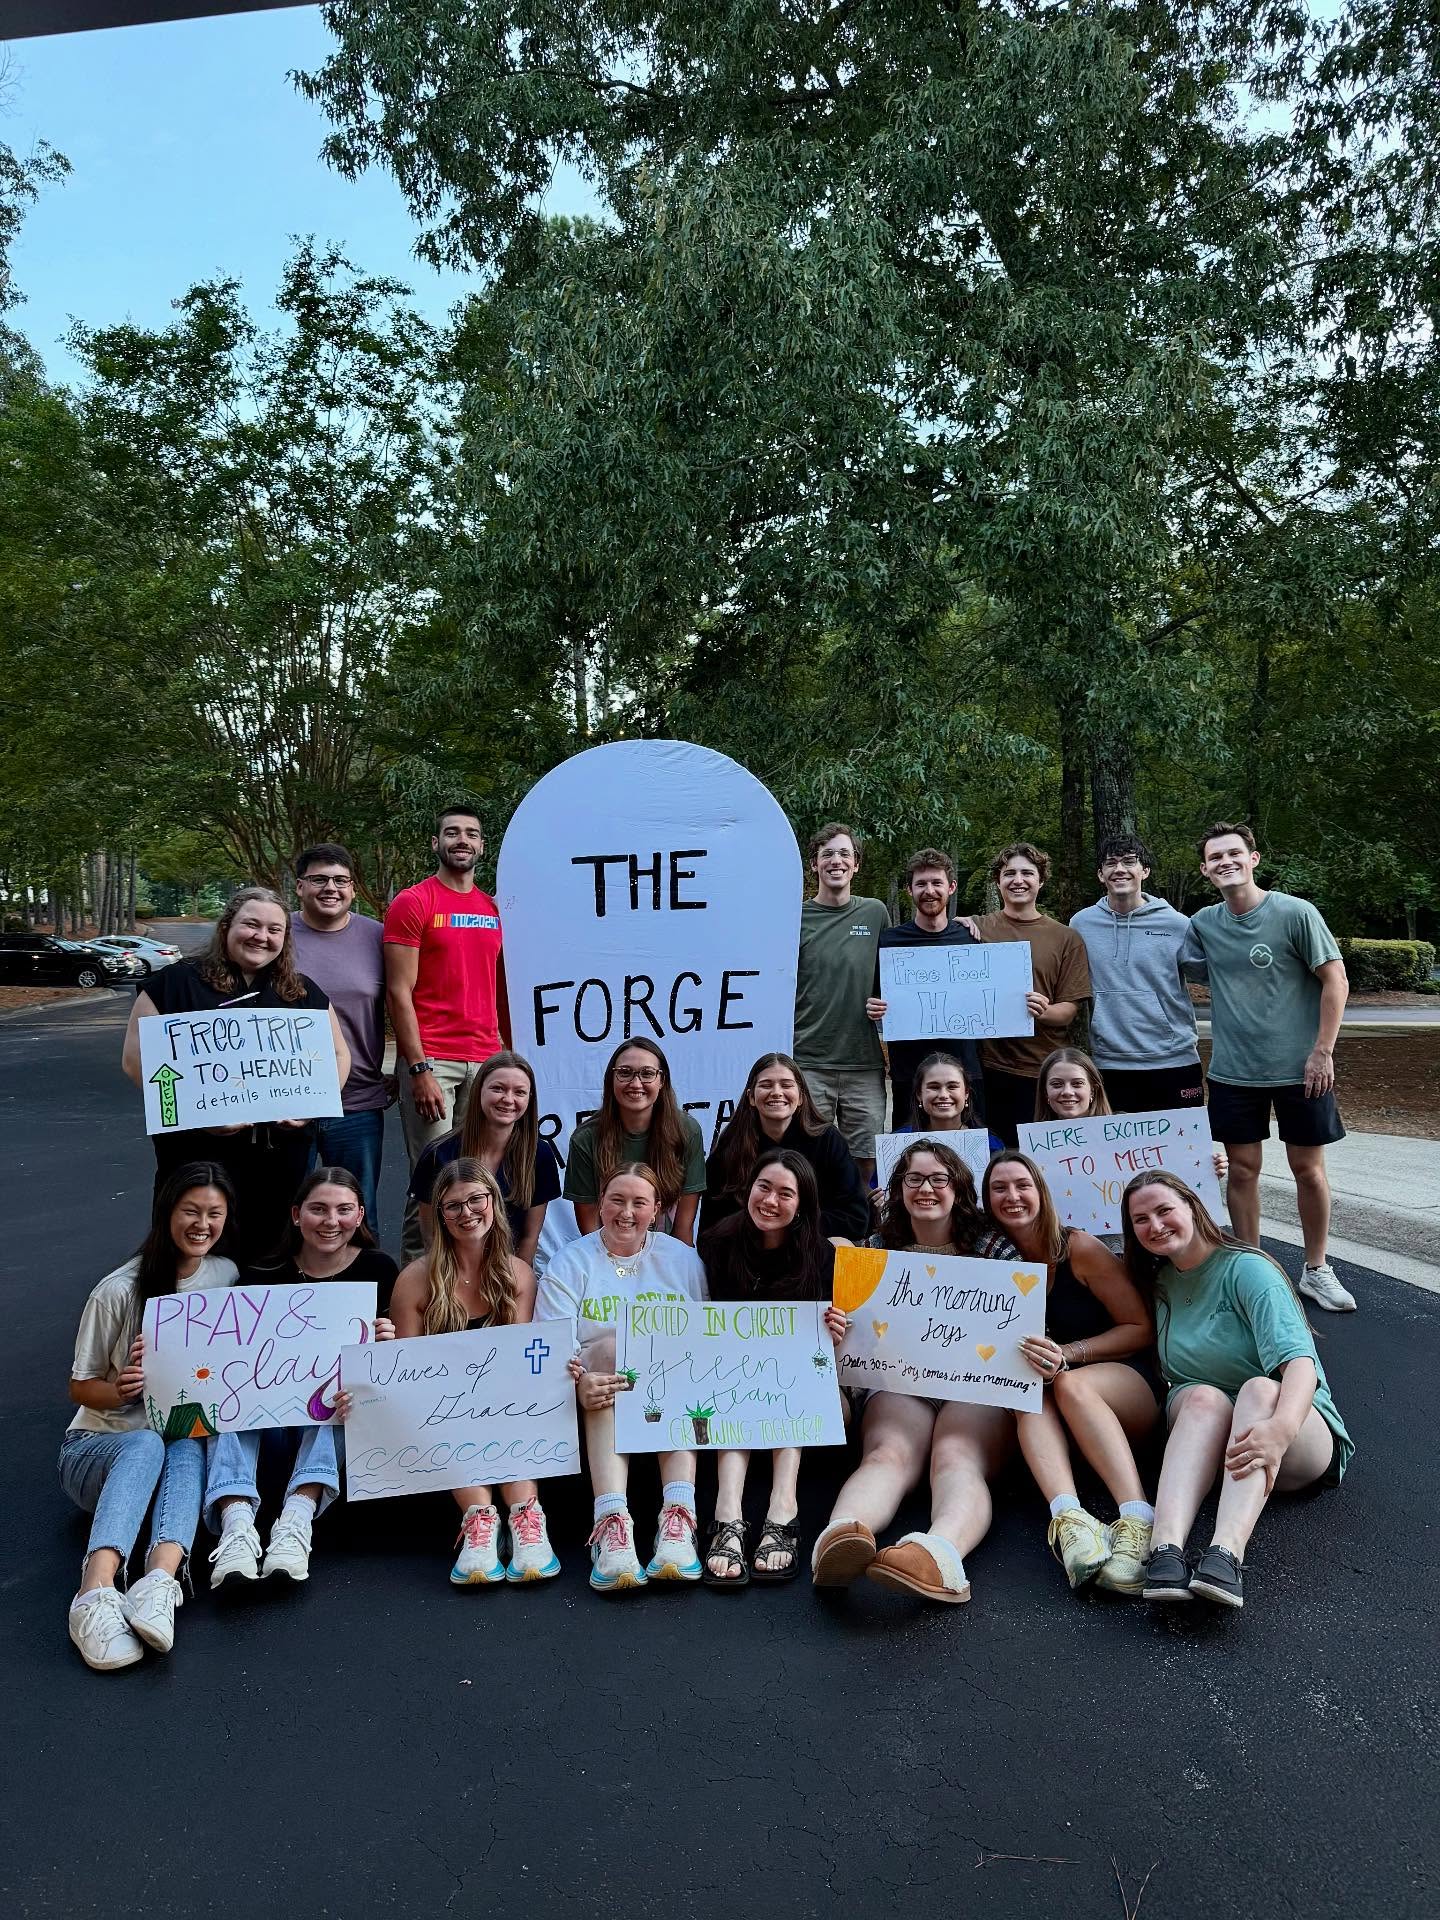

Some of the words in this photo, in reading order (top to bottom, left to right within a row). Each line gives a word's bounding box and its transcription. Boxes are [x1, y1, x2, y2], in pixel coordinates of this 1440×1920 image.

[571, 850, 707, 917] THE
[533, 971, 760, 1046] FORGE
[248, 1015, 315, 1055] TRIP
[193, 1063, 229, 1084] TO
[240, 1059, 312, 1080] HEAVEN
[196, 1089, 259, 1111] details
[1104, 1118, 1171, 1141] EXCITED
[1059, 1155, 1095, 1175] TO
[1114, 1145, 1168, 1172] MEET
[887, 1268, 924, 1307] the
[155, 1290, 270, 1351] PRAY
[276, 1288, 327, 1338] &
[631, 1304, 689, 1337] ROOTED
[703, 1306, 726, 1336] IN
[733, 1305, 800, 1340] CHRIST
[921, 1318, 968, 1348] joys
[218, 1338, 342, 1422] slay
[364, 1349, 449, 1385] Waves
[465, 1347, 497, 1393] of
[647, 1351, 796, 1400] green
[922, 1367, 948, 1381] comes
[949, 1370, 961, 1382] in
[962, 1372, 981, 1383] the
[418, 1391, 566, 1430] Grace
[700, 1380, 804, 1419] team
